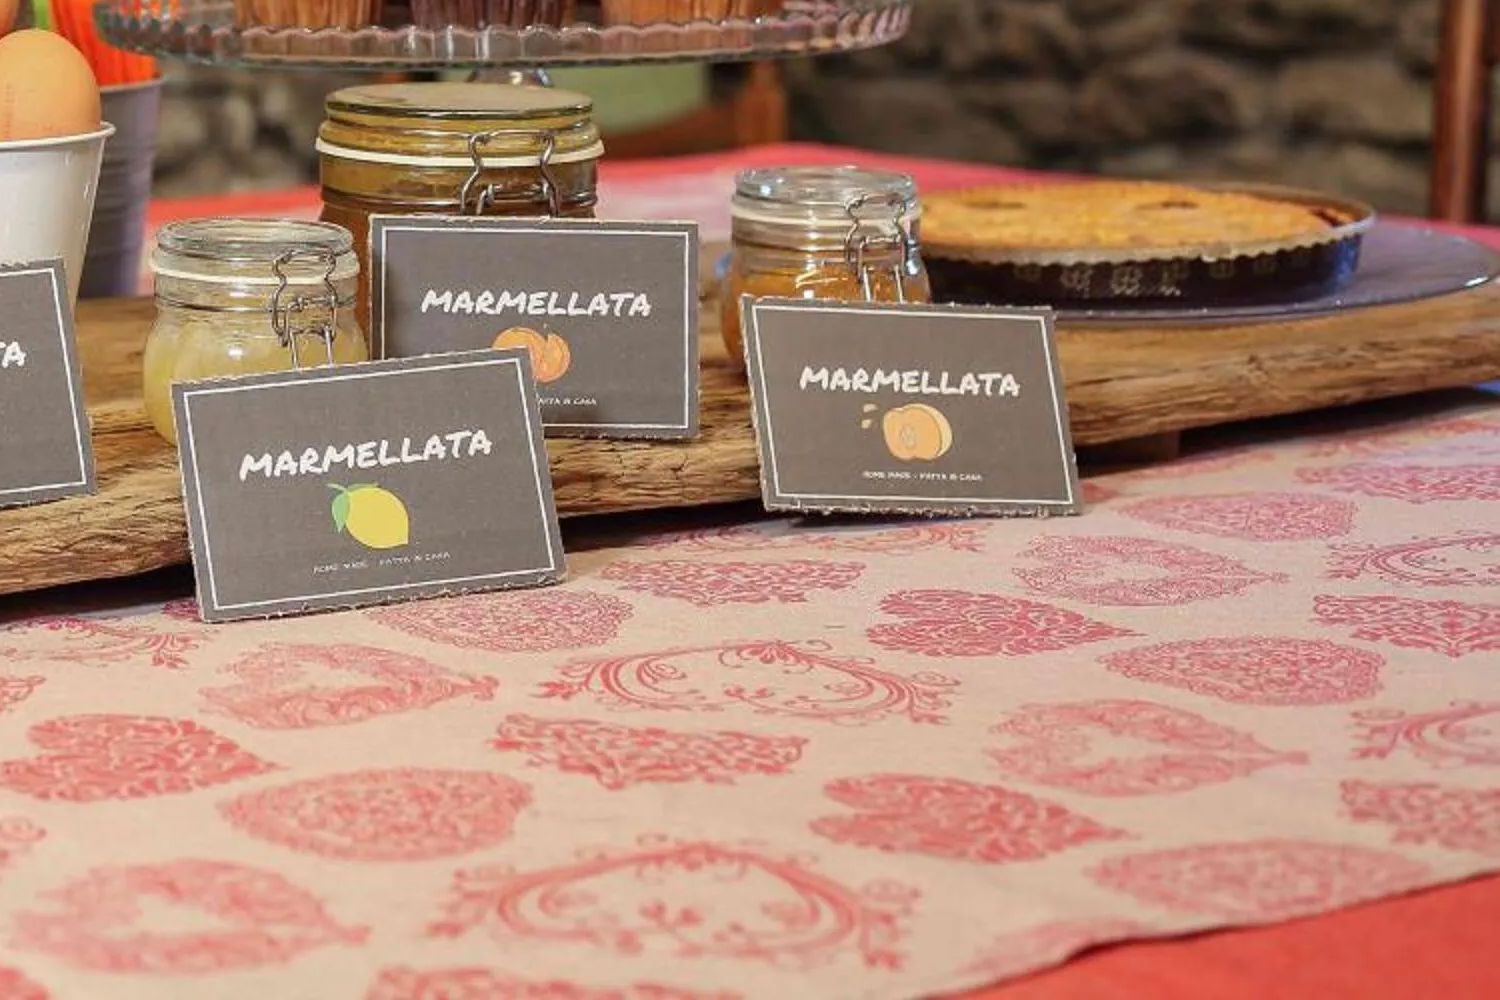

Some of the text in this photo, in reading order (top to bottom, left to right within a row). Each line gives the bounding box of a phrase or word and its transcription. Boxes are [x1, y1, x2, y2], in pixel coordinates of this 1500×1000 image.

[421, 289, 652, 317] MARMELLATA
[799, 366, 1021, 397] MARMELLATA
[239, 429, 494, 481] MARMELLATA
